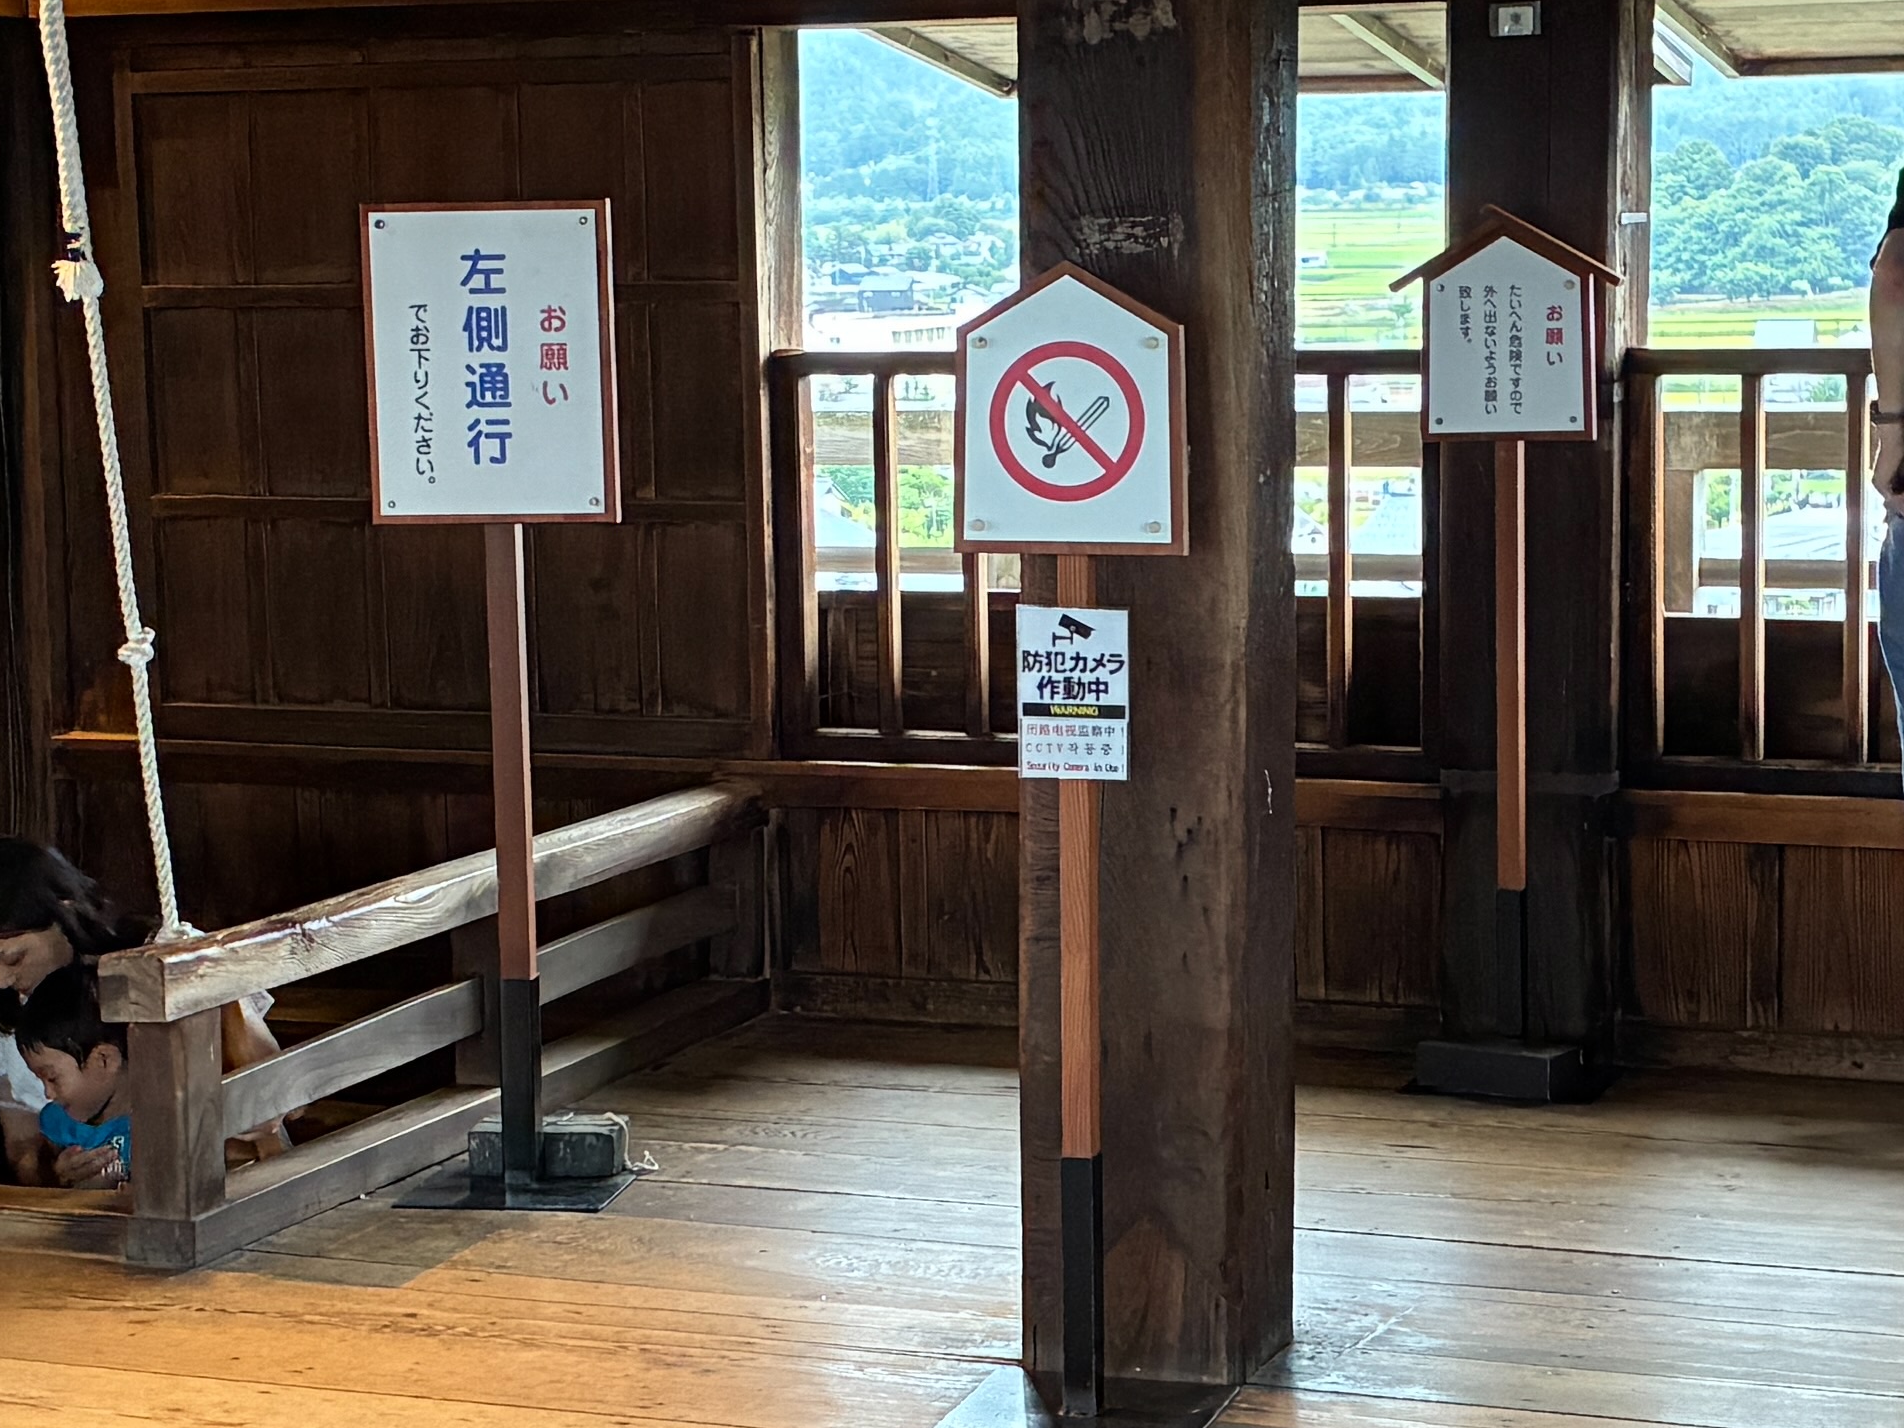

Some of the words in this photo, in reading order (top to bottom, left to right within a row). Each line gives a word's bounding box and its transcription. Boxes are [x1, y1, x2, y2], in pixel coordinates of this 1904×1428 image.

[1458, 285, 1473, 344] 致します。
[1483, 285, 1498, 415] 外へ出ないようお願い
[1509, 284, 1523, 414] たいへん危険ですので
[1546, 305, 1564, 366] お願い
[408, 304, 436, 485] でお下りください。
[460, 248, 512, 465] 左側通行
[539, 305, 569, 406] お願い
[1021, 649, 1125, 675] 防犯カメラ
[1036, 675, 1109, 702] 作動中
[1050, 704, 1099, 716] WARNING
